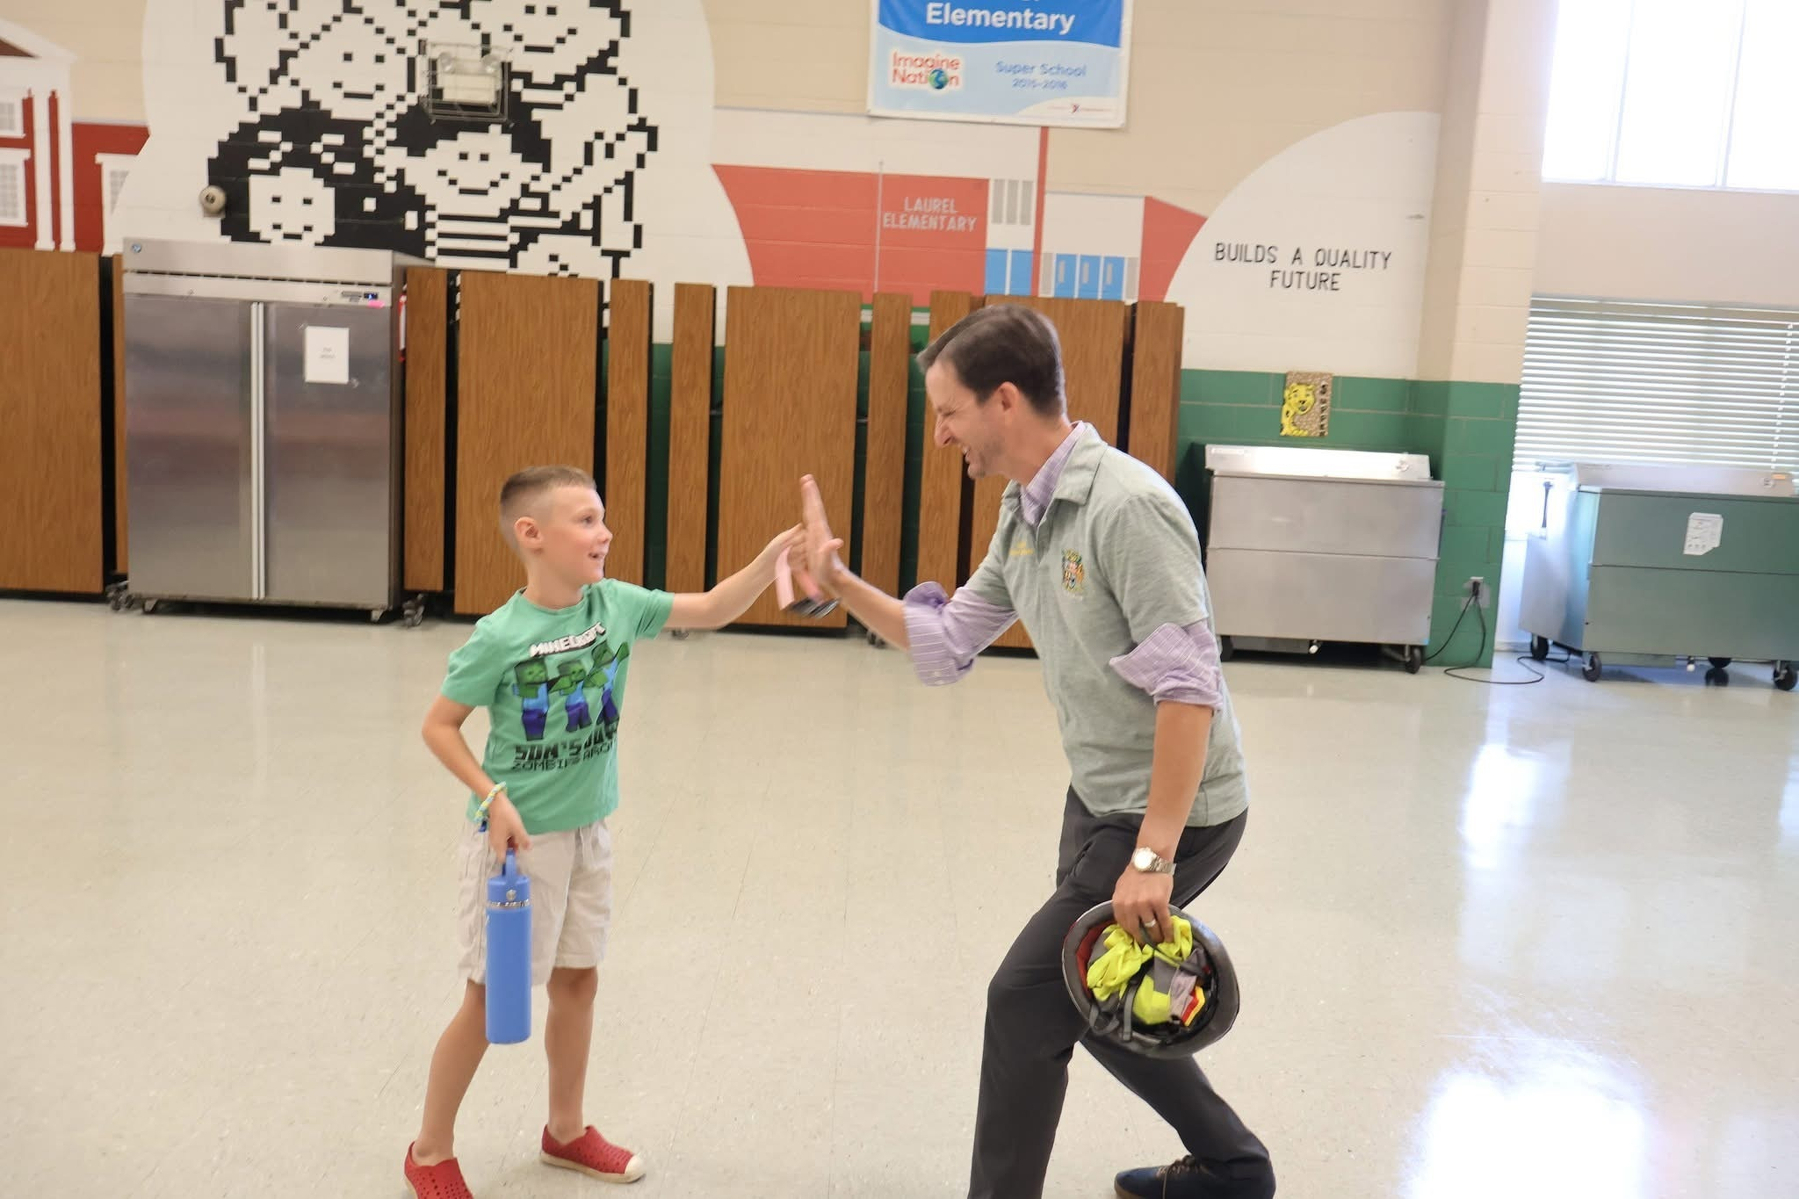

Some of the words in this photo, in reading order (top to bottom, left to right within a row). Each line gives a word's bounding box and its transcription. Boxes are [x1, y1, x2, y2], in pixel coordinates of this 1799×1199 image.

[926, 3, 1076, 35] Elementary
[892, 51, 960, 70] Imagine
[995, 61, 1034, 75] Super
[1040, 63, 1086, 77] School
[904, 196, 957, 214] LAUREL
[883, 212, 977, 232] ELEMENTARY
[1214, 242, 1279, 264] BUILDS
[1291, 247, 1304, 265] A
[1315, 248, 1392, 270] QUALITY
[1269, 269, 1342, 291] FUTURE
